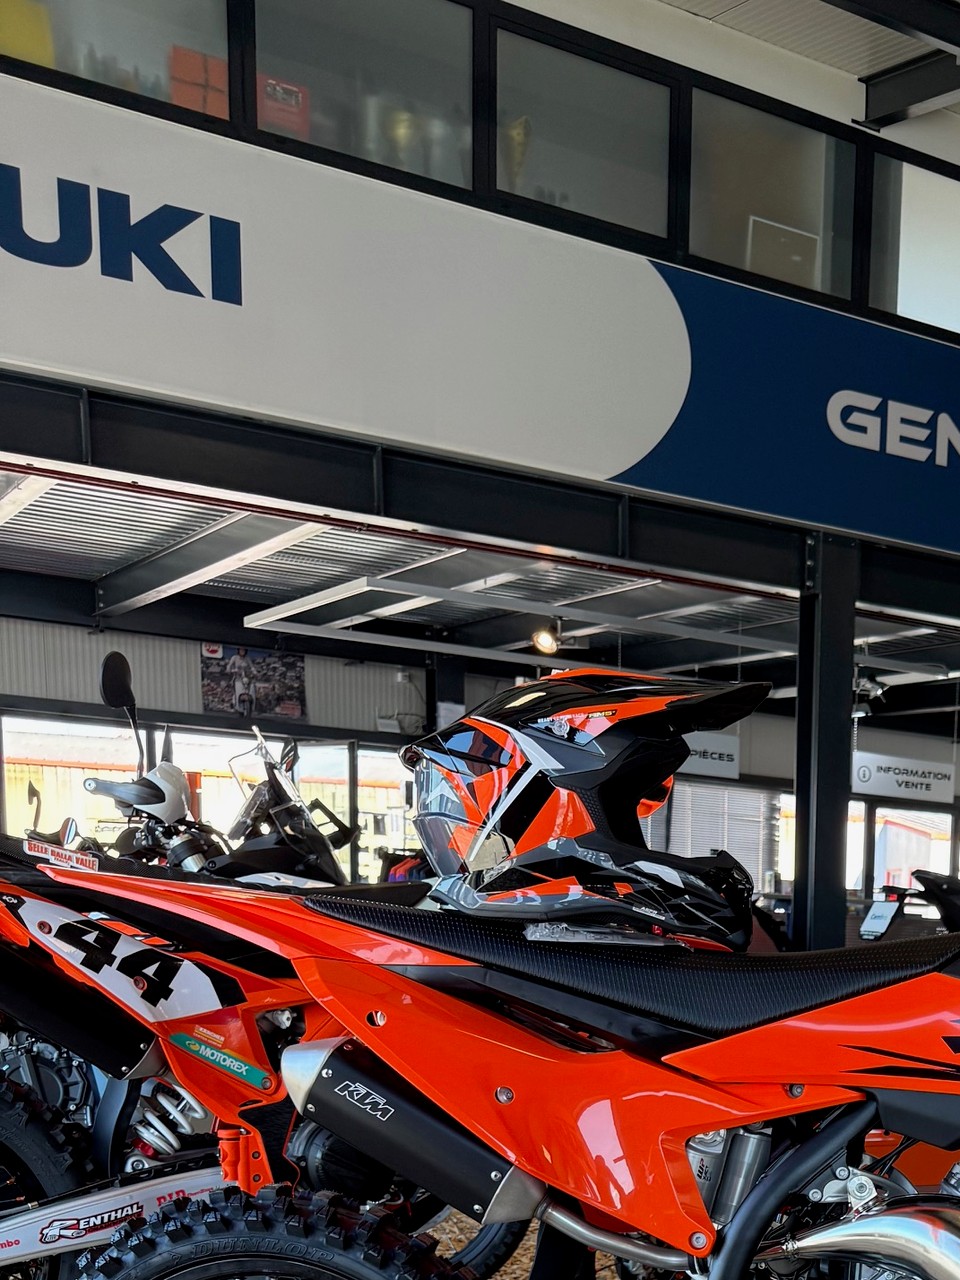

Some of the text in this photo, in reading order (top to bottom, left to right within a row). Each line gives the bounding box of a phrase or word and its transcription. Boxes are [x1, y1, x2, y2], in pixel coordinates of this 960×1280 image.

[690, 748, 735, 763] PIÈCES
[876, 765, 951, 782] INFORMATION
[896, 779, 931, 792] VENTE
[28, 841, 48, 855] SELLE
[53, 919, 185, 1008] 44
[199, 1045, 249, 1075] MOTOREX
[334, 1080, 395, 1121] KTM
[192, 1237, 335, 1262] DUNLOP
